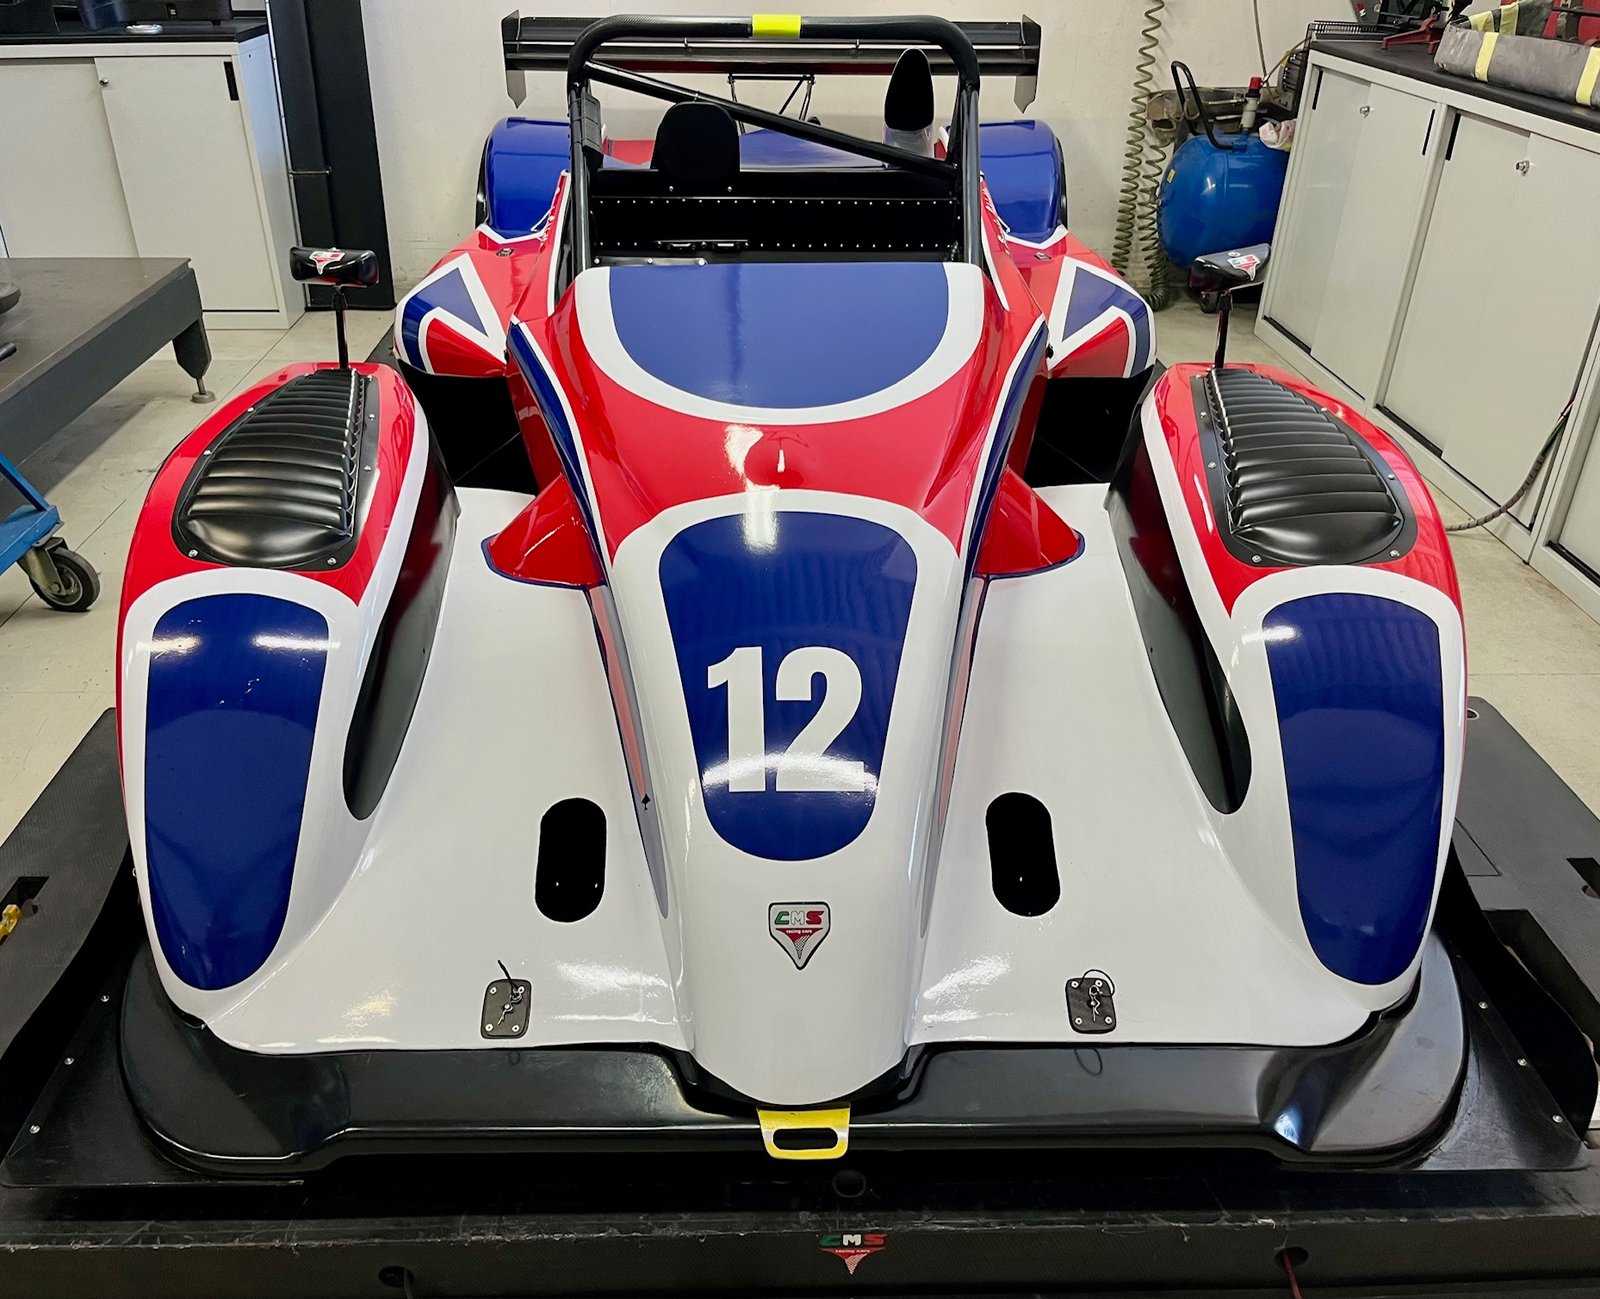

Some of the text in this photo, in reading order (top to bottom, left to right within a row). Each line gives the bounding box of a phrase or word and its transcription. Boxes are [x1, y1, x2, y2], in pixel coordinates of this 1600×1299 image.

[707, 645, 865, 793] 12
[774, 910, 825, 926] CMS
[820, 1233, 888, 1247] CMS
